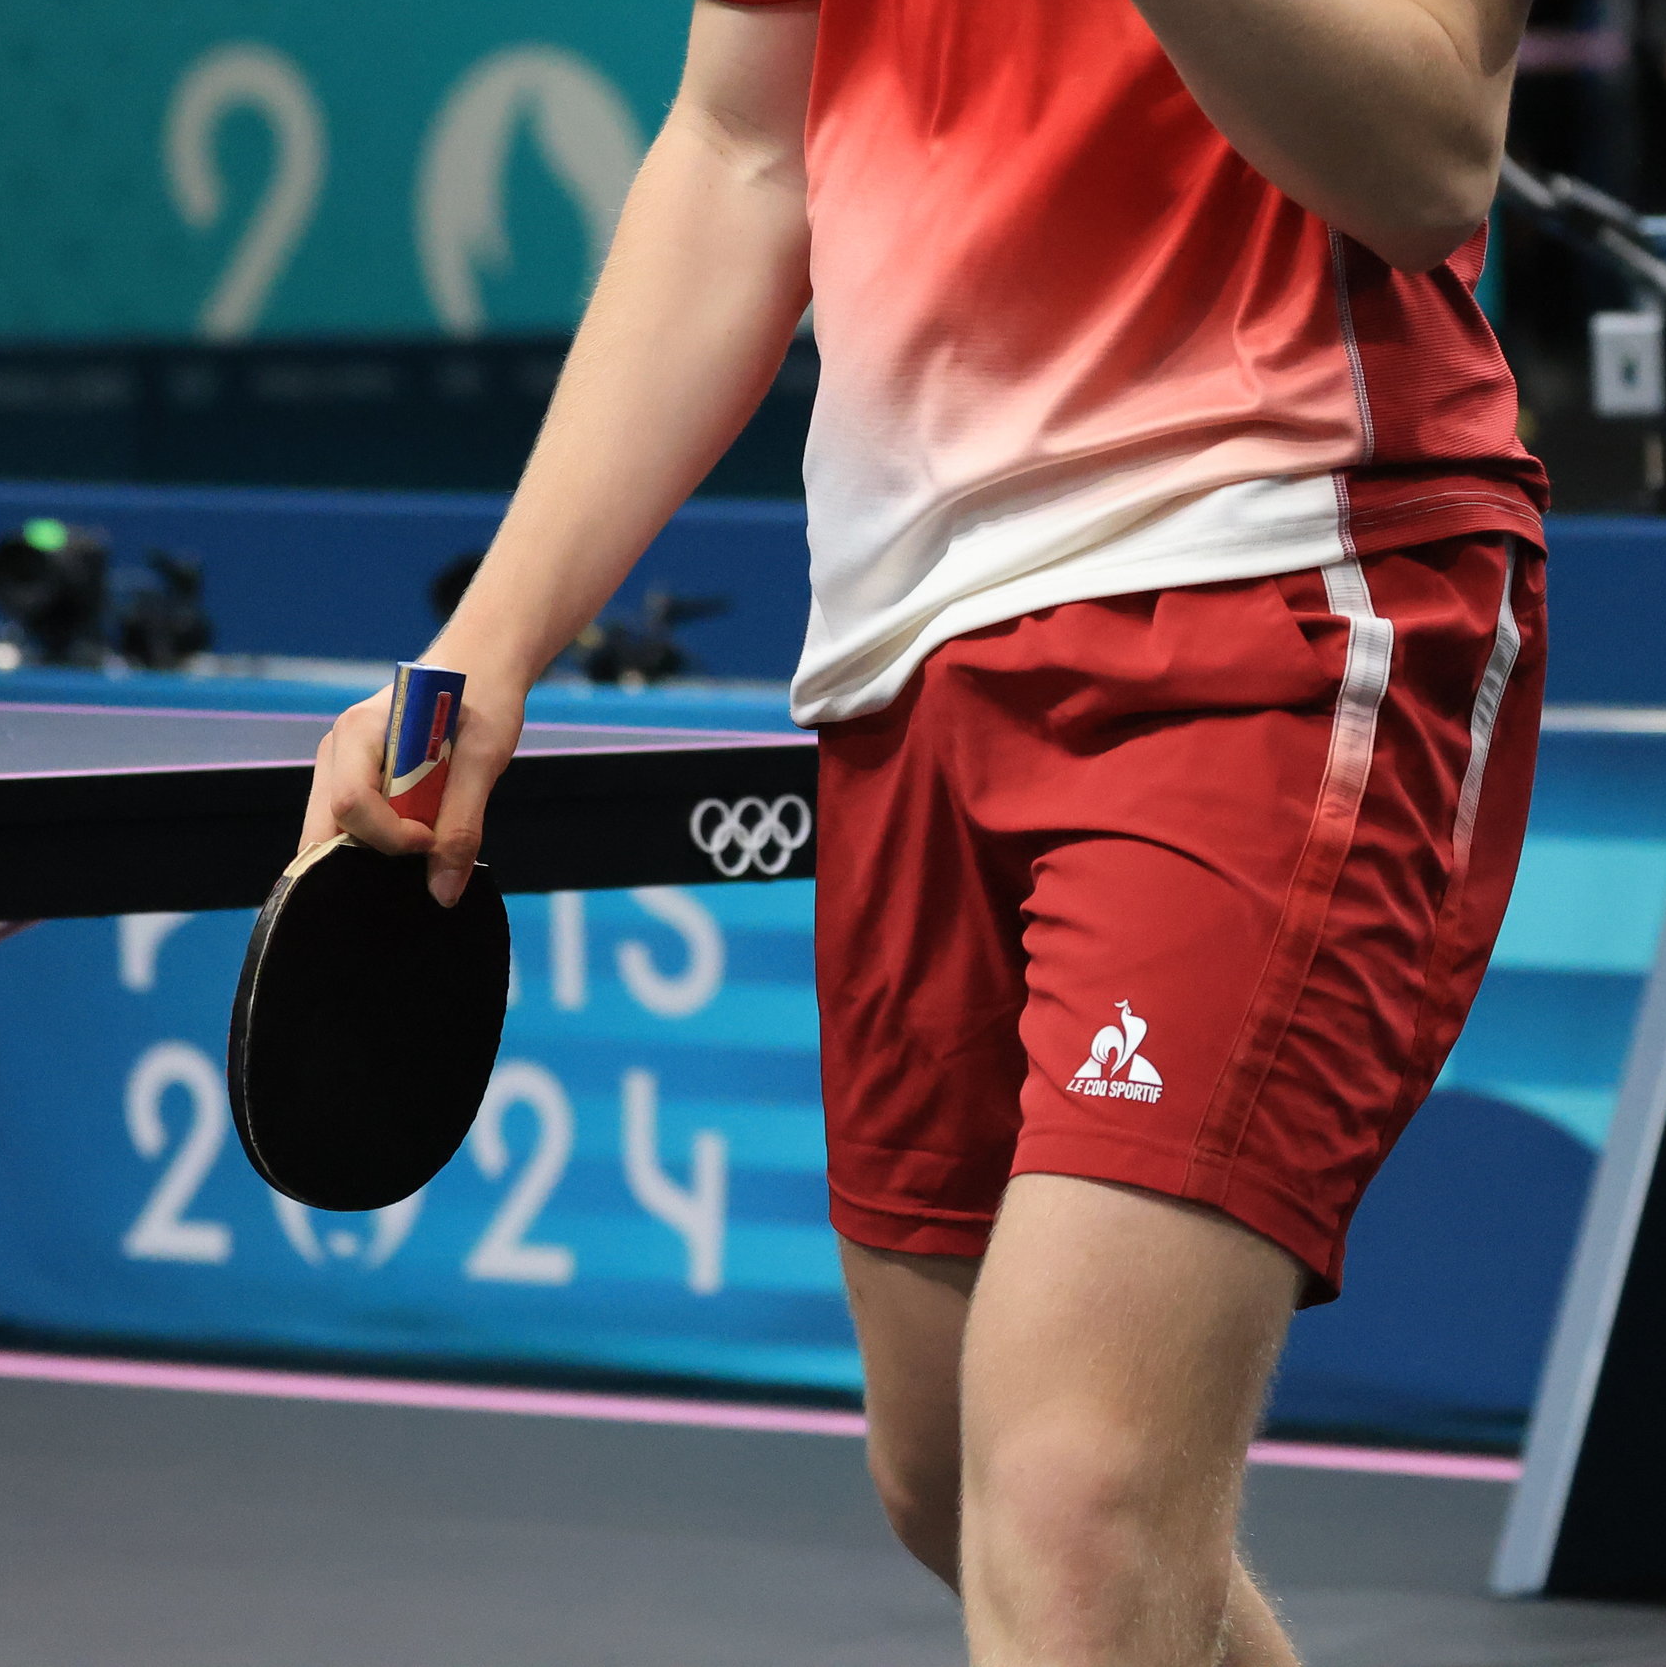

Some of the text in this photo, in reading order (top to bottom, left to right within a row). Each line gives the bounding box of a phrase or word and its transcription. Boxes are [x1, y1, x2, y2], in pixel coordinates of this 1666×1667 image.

[1066, 1079, 1163, 1104] LE COQ SPORTIF
[121, 1040, 728, 1295] 224
